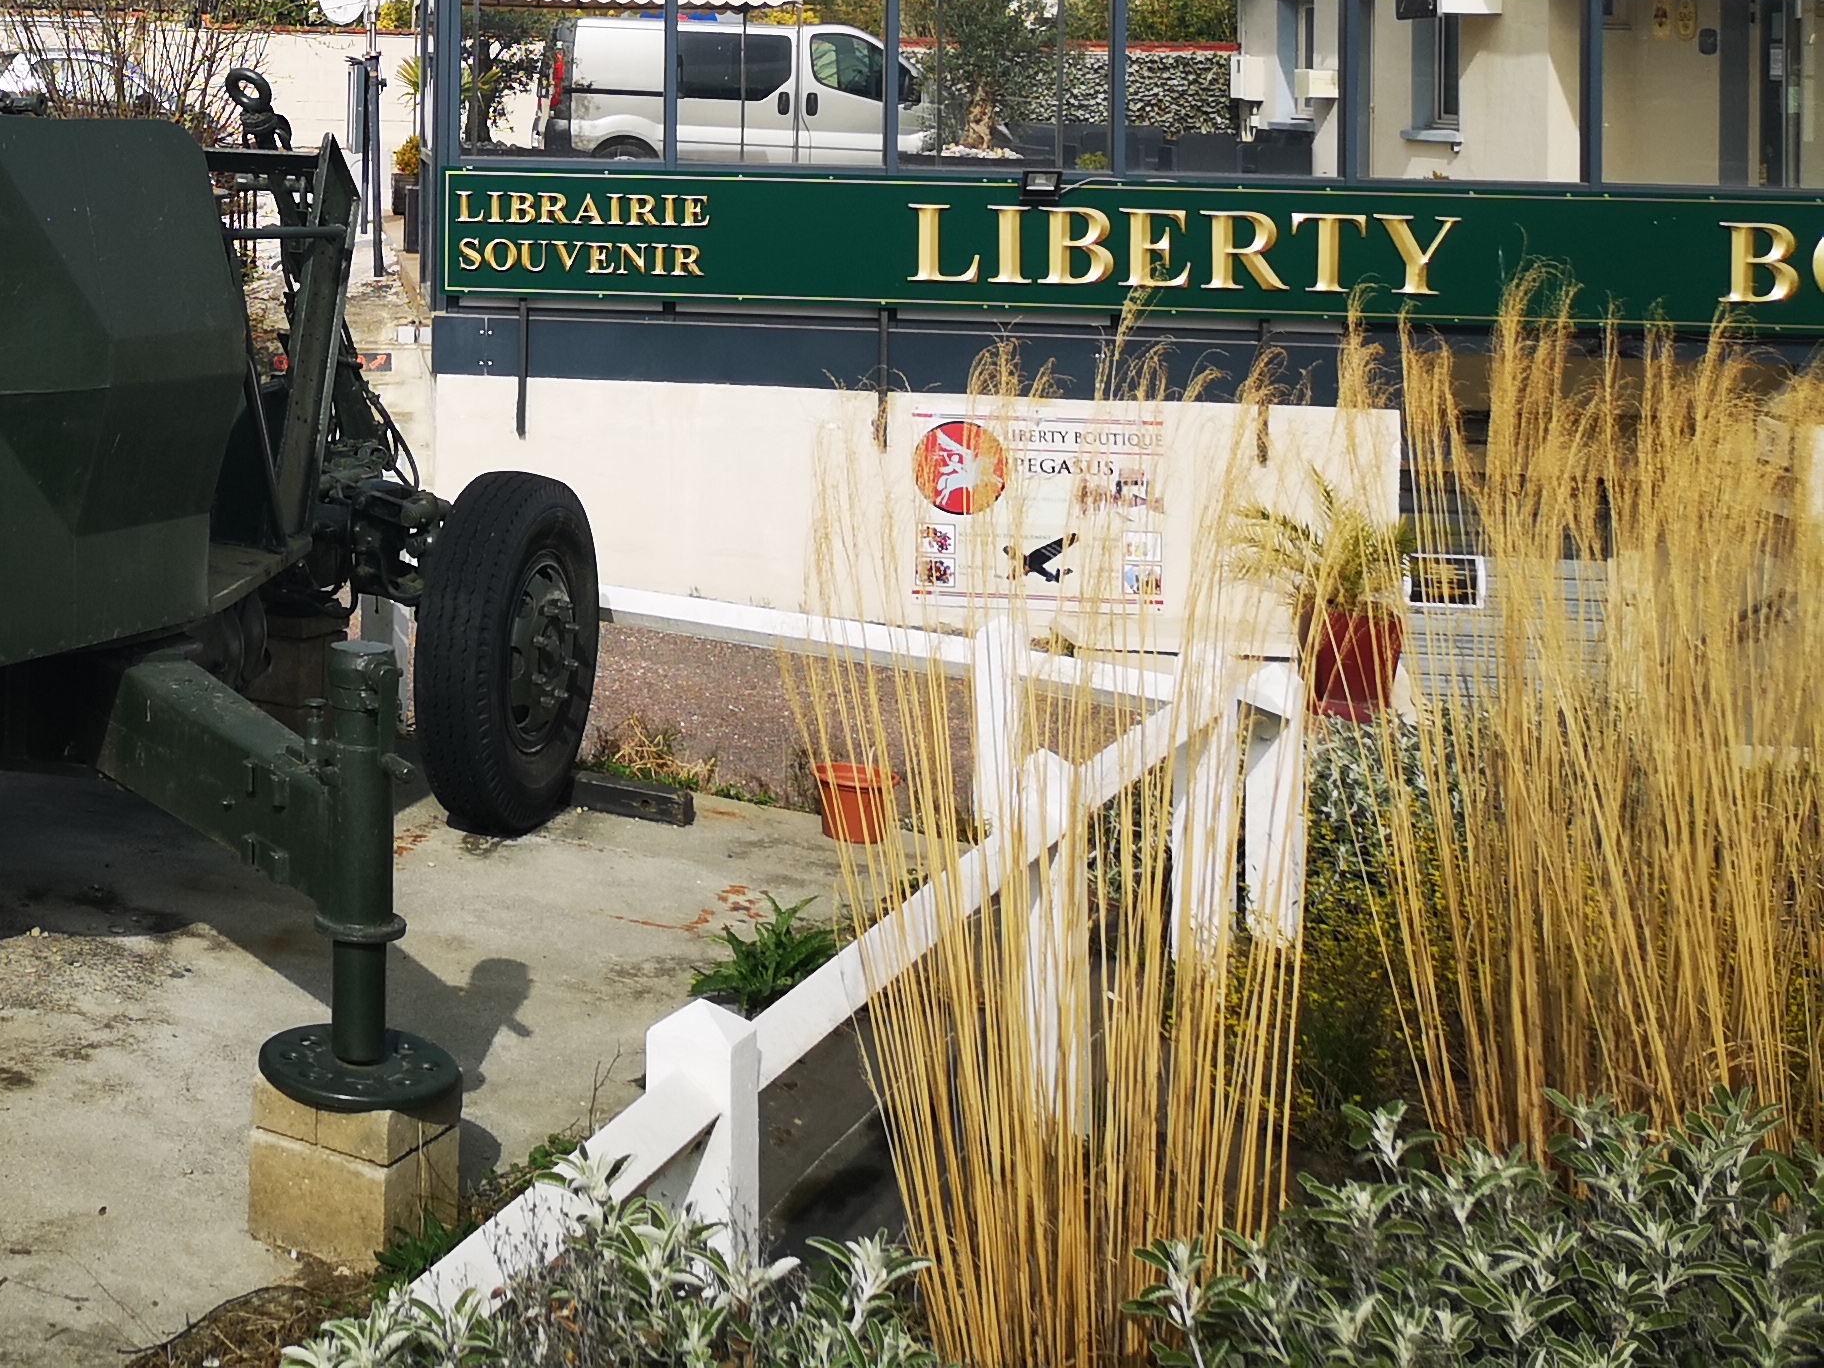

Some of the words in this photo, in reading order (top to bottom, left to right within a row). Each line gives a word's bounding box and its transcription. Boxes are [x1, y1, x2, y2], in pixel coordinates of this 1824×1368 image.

[455, 190, 711, 227] LIBRAIRIE
[458, 237, 705, 277] SOUVENIR
[906, 203, 1463, 296] LIBERTY
[1717, 221, 1824, 303] B
[1005, 428, 1069, 444] IBERTY
[1075, 431, 1164, 450] BOUTIQUE
[1014, 457, 1114, 477] PEGASUS
